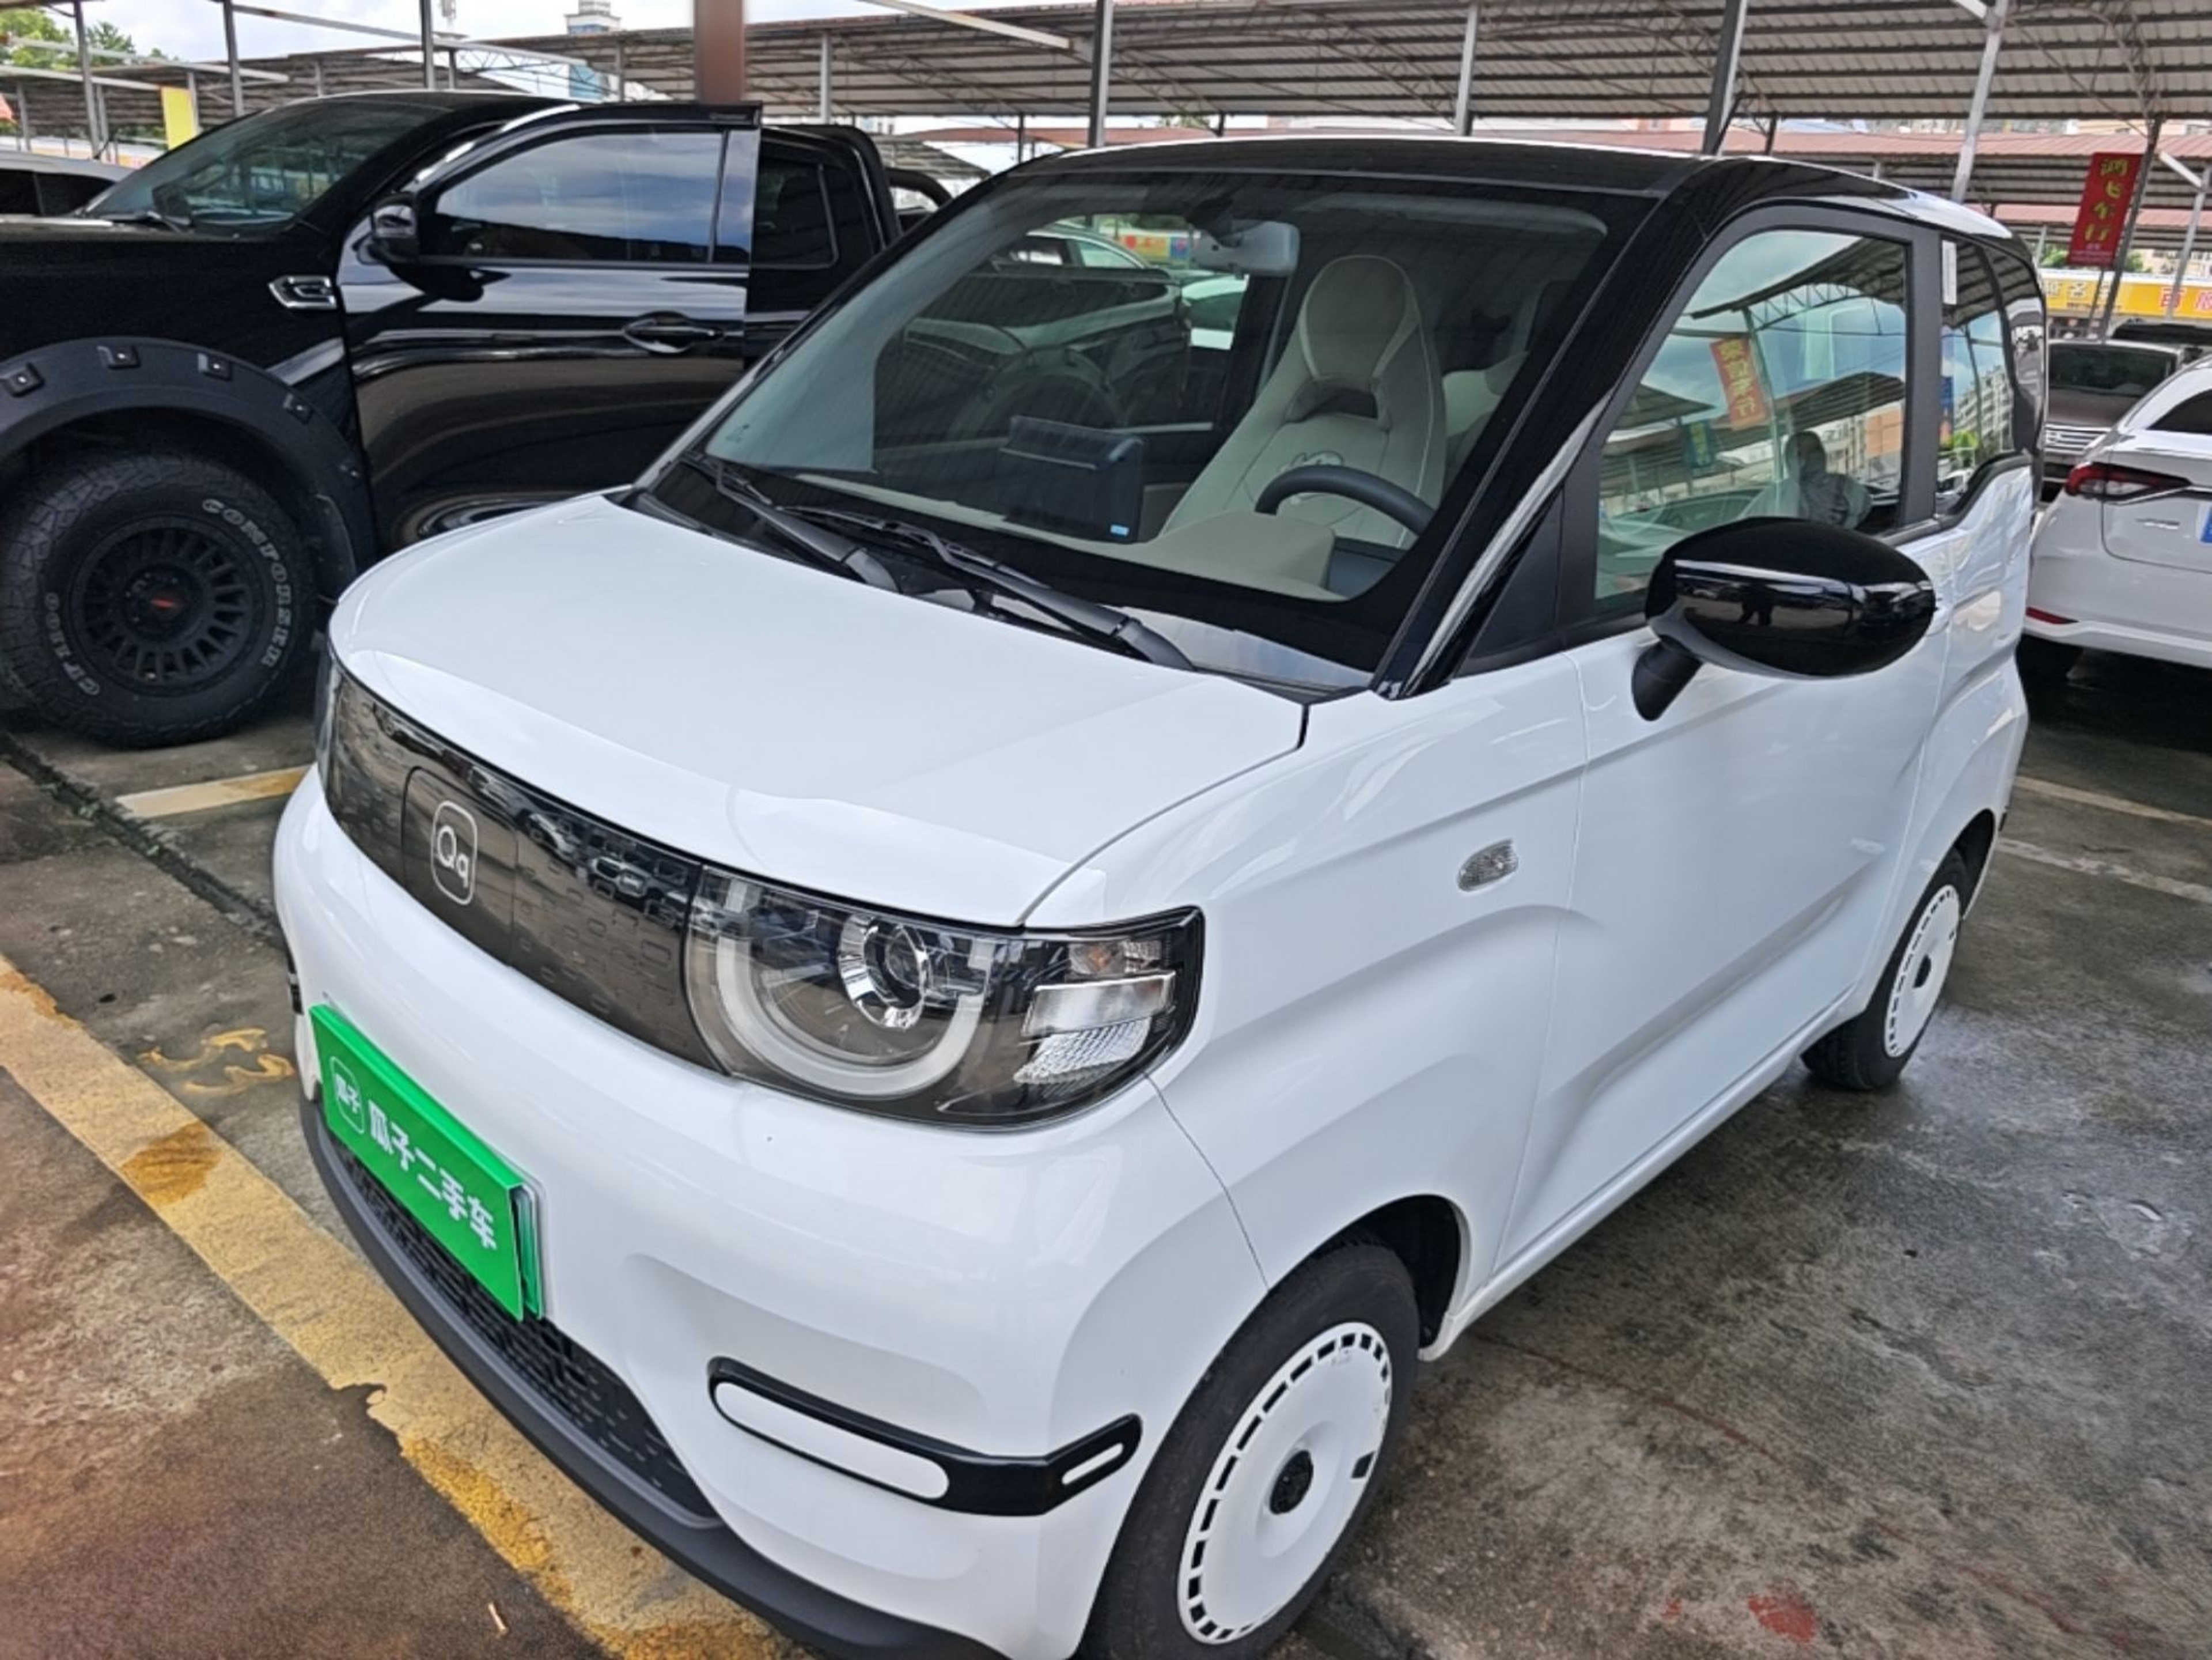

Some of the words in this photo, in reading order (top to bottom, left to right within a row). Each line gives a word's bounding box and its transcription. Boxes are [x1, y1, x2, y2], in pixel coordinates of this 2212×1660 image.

[368, 1099, 497, 1249] 瓜子二手车
